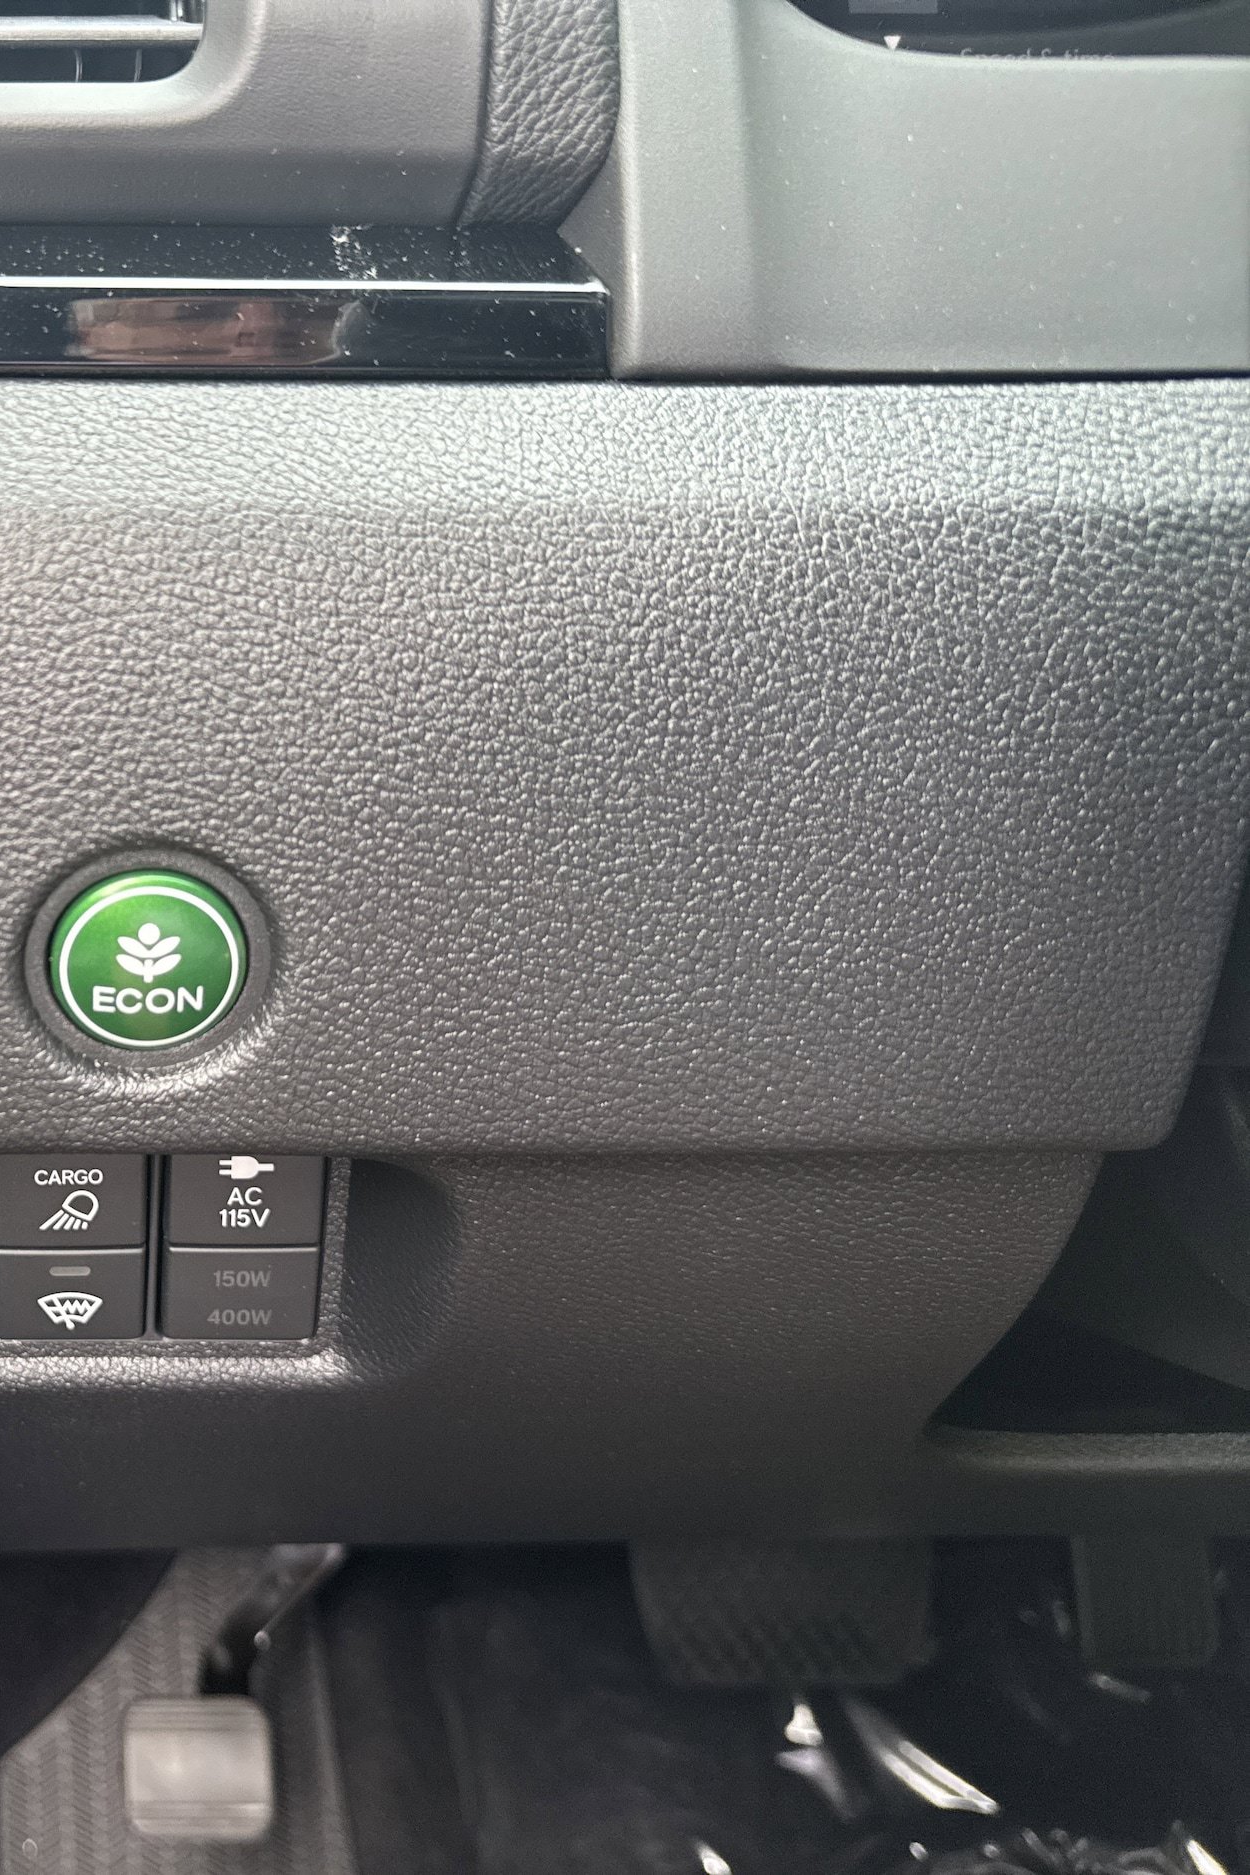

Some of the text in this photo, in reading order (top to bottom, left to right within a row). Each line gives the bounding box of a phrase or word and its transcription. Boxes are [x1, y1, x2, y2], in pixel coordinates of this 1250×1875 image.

[92, 985, 204, 1016] ECON
[33, 1168, 105, 1187] CARGO
[226, 1186, 264, 1207] AC
[218, 1207, 271, 1229] 115V
[212, 1269, 271, 1289] 150W
[206, 1308, 273, 1327] 400W
